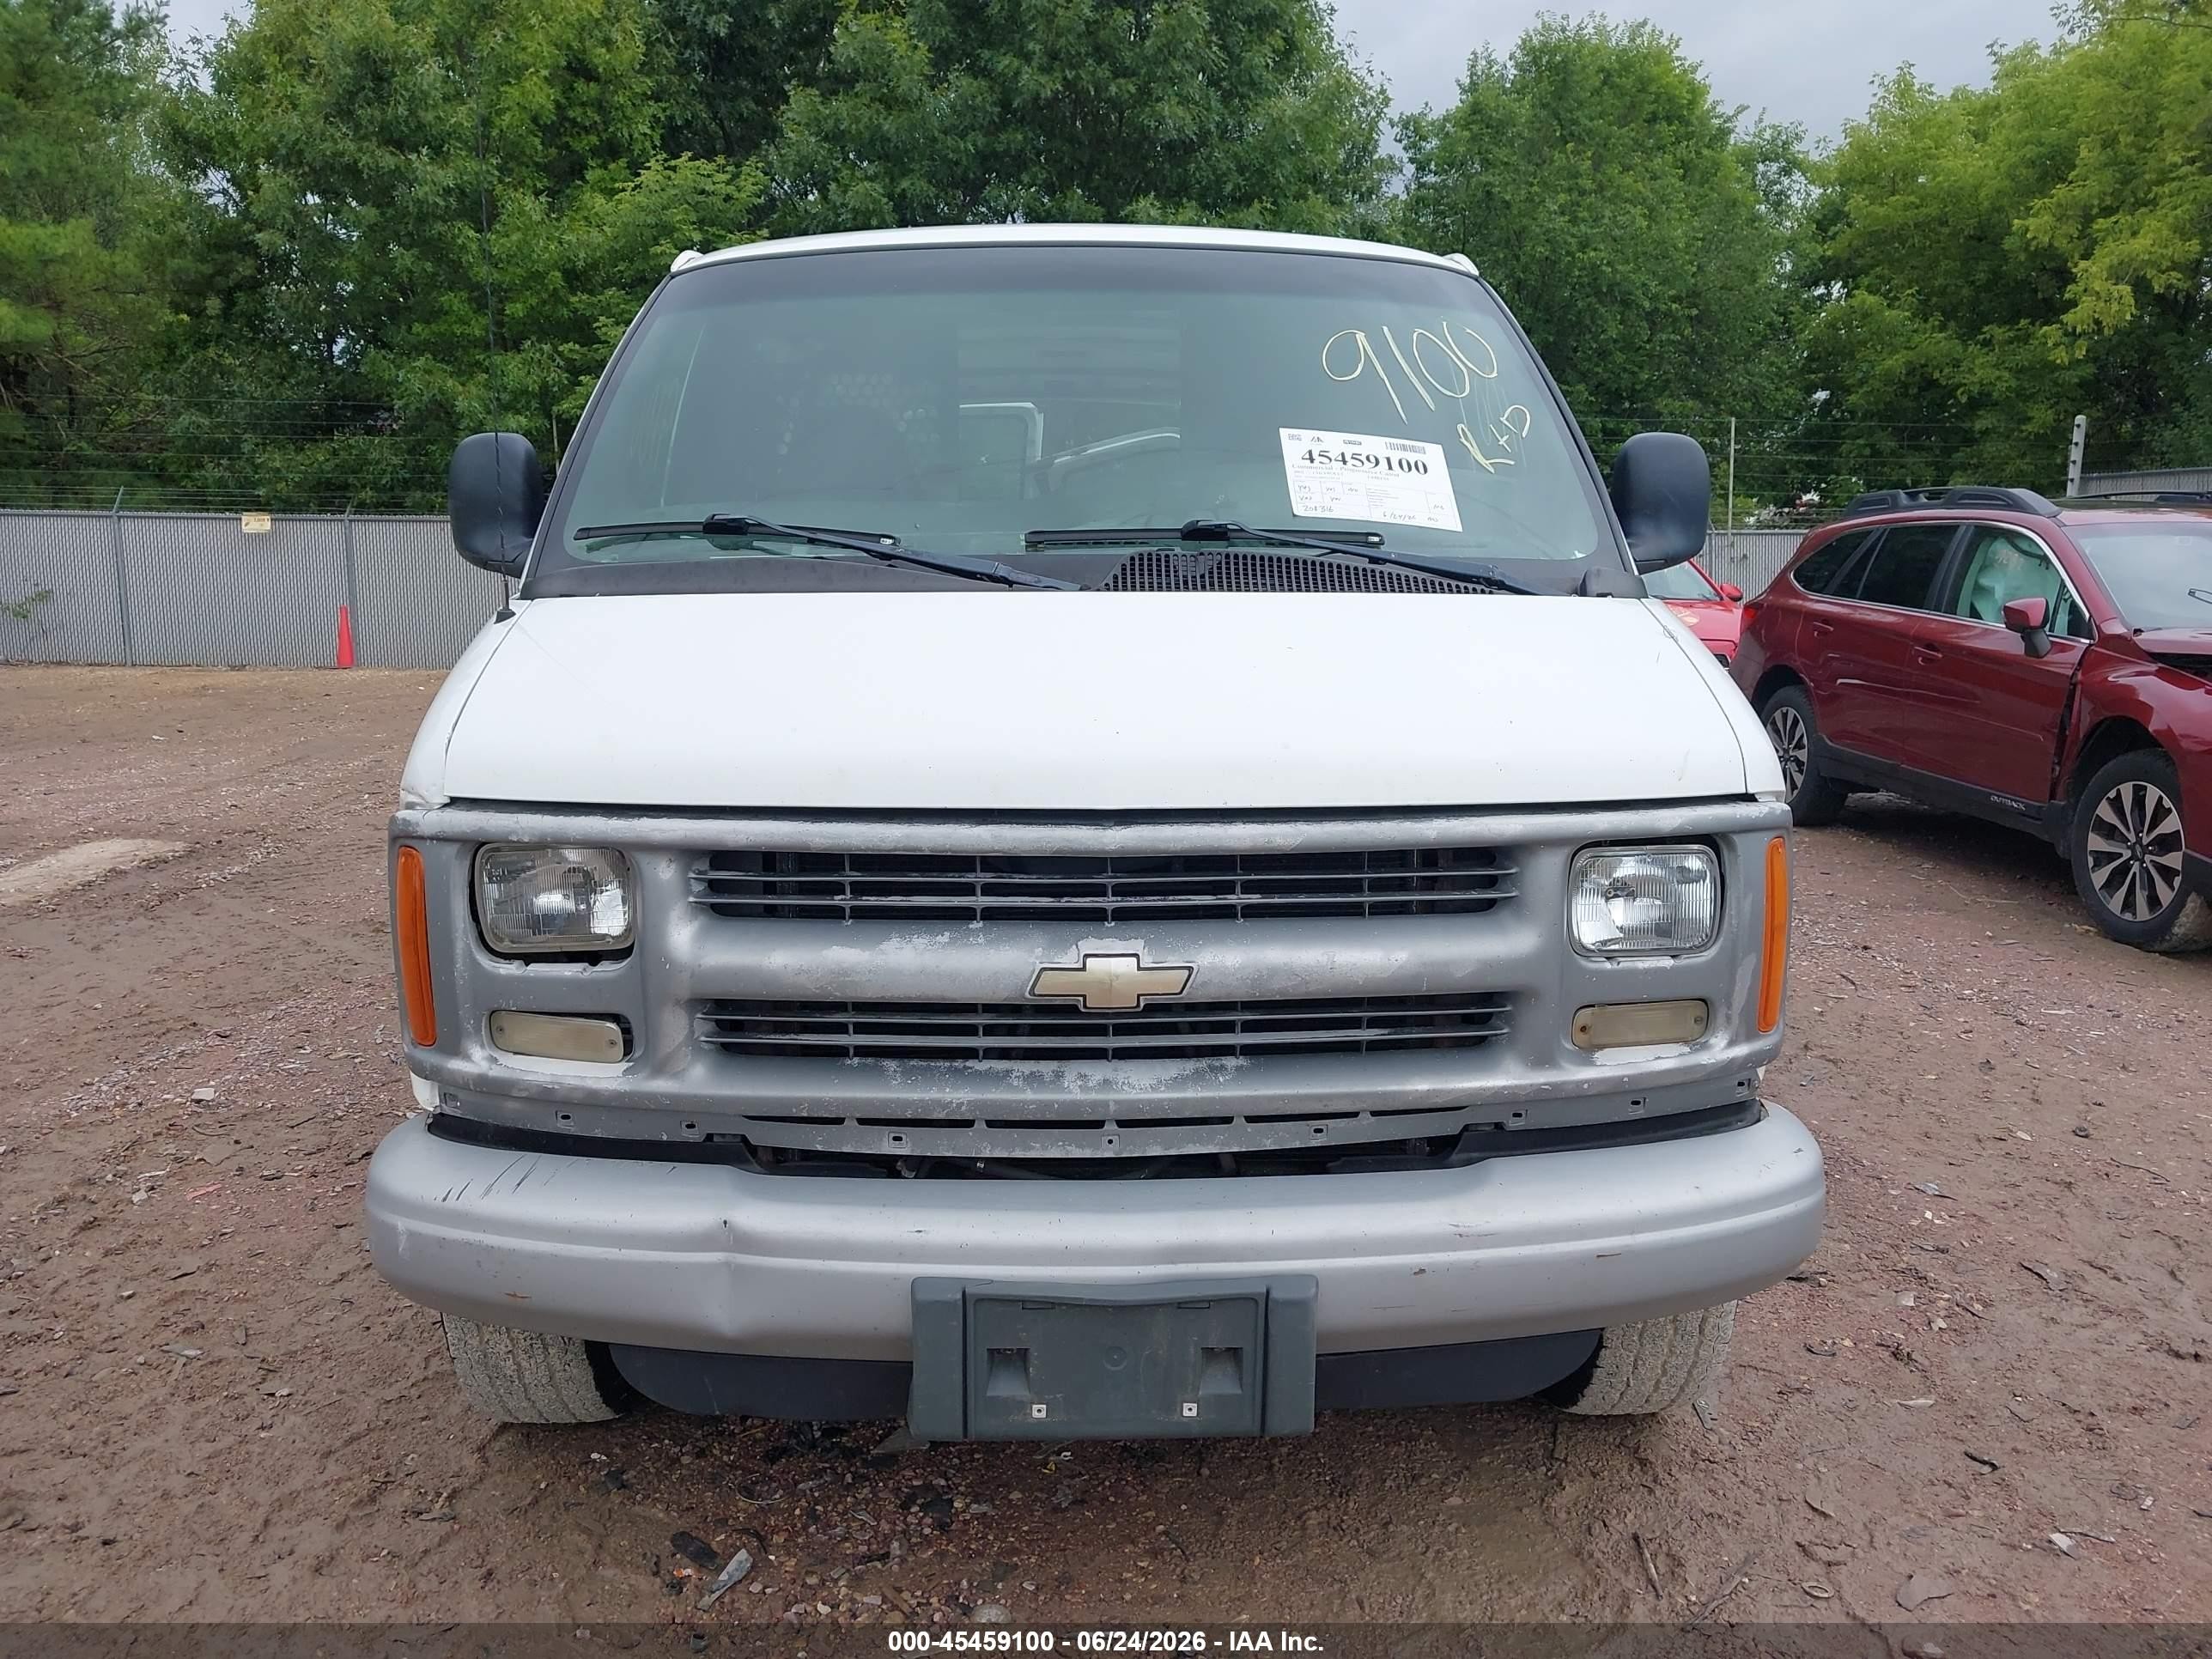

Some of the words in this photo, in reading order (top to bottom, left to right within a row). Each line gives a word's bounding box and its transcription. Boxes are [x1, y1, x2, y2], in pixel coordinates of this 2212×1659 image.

[1322, 320, 1498, 424] 9100
[1301, 449, 1428, 475] 45459100
[1990, 795, 2027, 811] OUTBACK
